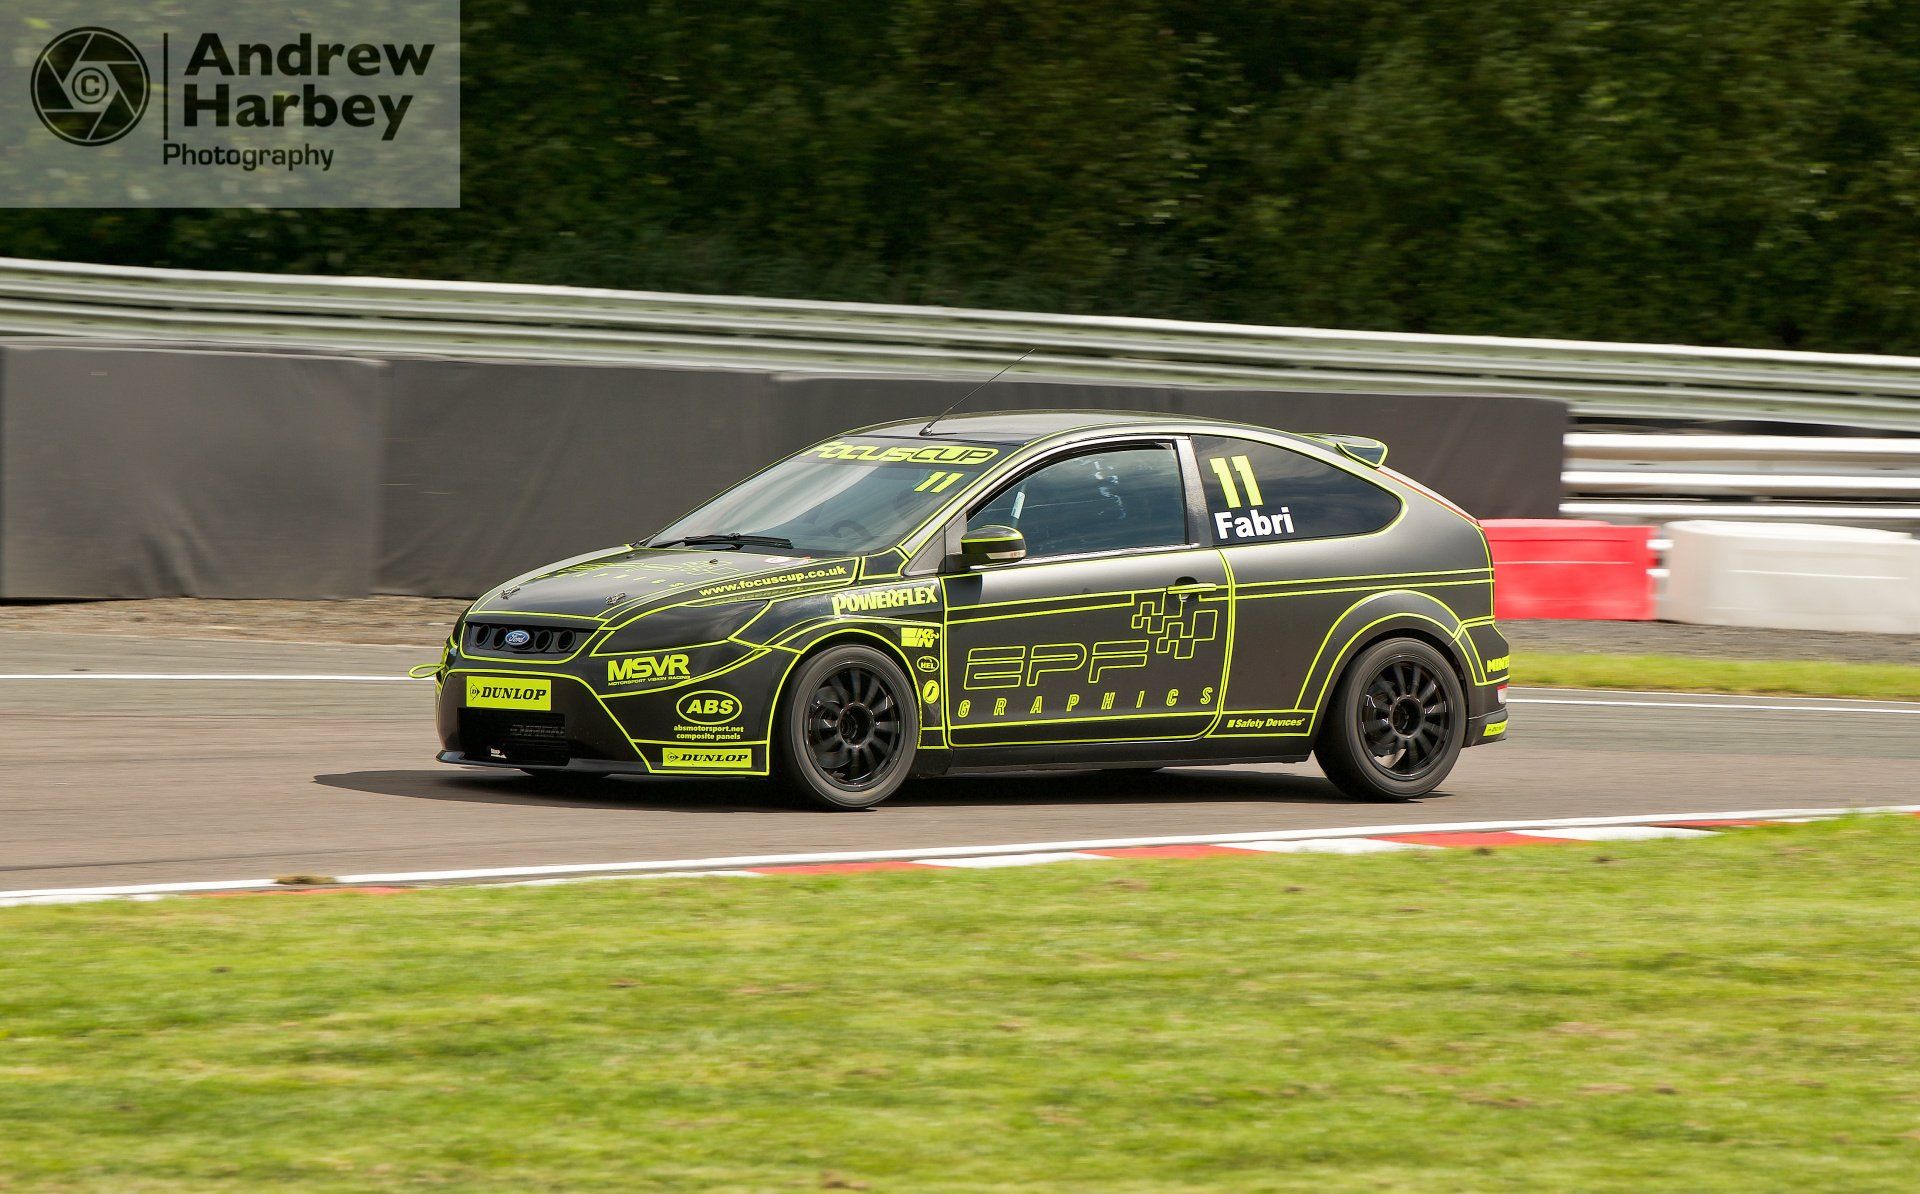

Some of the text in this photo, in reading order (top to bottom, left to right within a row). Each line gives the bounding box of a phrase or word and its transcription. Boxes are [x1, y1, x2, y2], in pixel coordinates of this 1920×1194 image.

[913, 471, 965, 493] 11
[1209, 455, 1264, 509] 11
[1214, 506, 1295, 539] Fabri
[699, 565, 847, 596] www.focuscup.co.uk
[831, 585, 938, 617] POWERFLEX
[608, 654, 691, 681] MSVR
[963, 640, 1149, 690] EPF
[608, 678, 646, 686] MOTORSPORT
[481, 686, 547, 700] DUNLOP
[686, 699, 734, 715] ABS
[673, 724, 744, 733] absmotorsport.net
[1235, 719, 1265, 728] Safety
[676, 732, 741, 741] composite panels
[681, 753, 748, 762] DUNLOP
